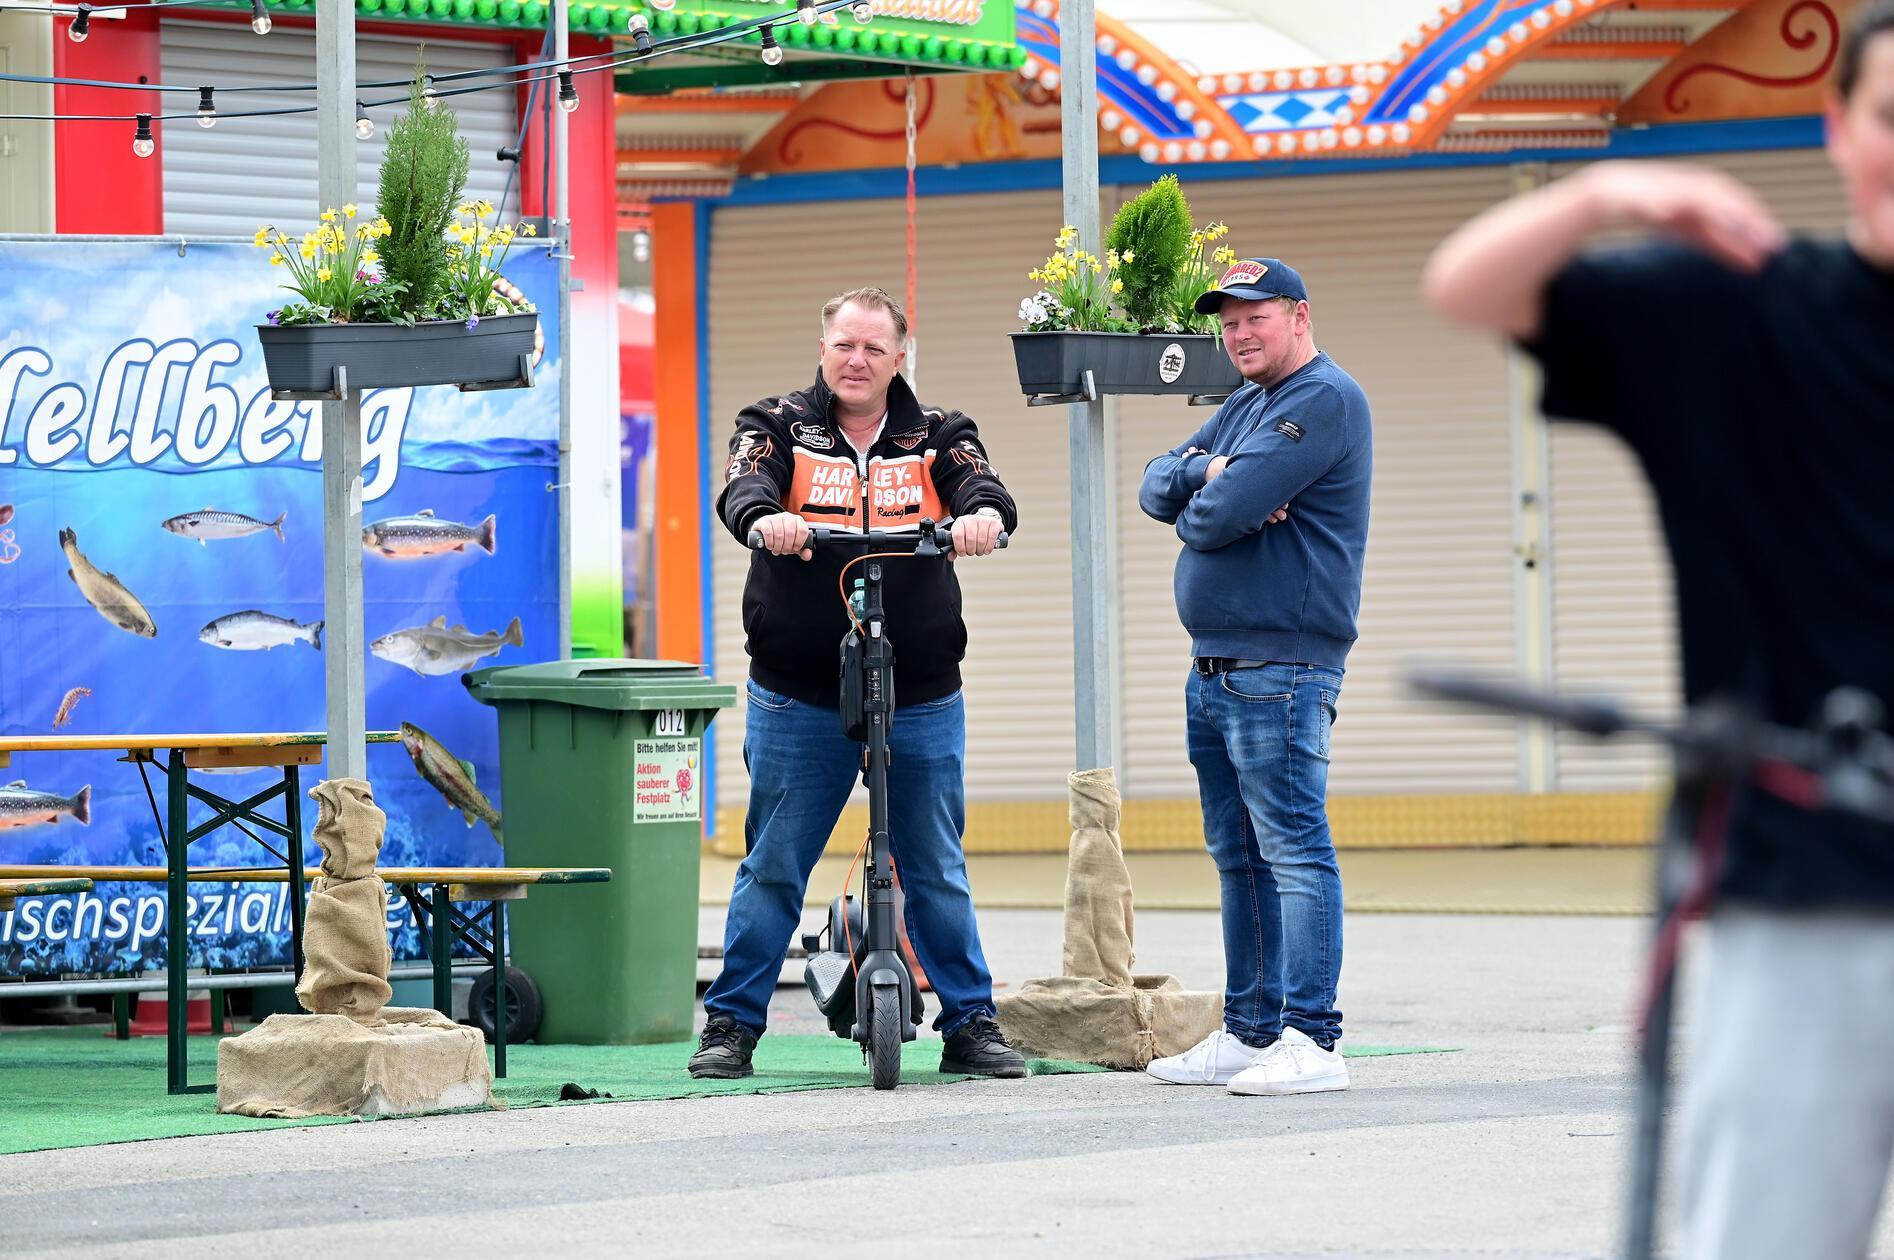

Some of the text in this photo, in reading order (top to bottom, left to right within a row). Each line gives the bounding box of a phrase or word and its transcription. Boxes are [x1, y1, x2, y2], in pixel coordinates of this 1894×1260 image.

[877, 507, 905, 519] Racing
[660, 709, 683, 732] 012
[636, 743, 654, 754] Bitte
[655, 742, 675, 753] helfen
[677, 742, 686, 752] Sie
[636, 763, 661, 775] Aktion
[636, 778, 669, 789] sauberer
[636, 793, 671, 805] Festplatz
